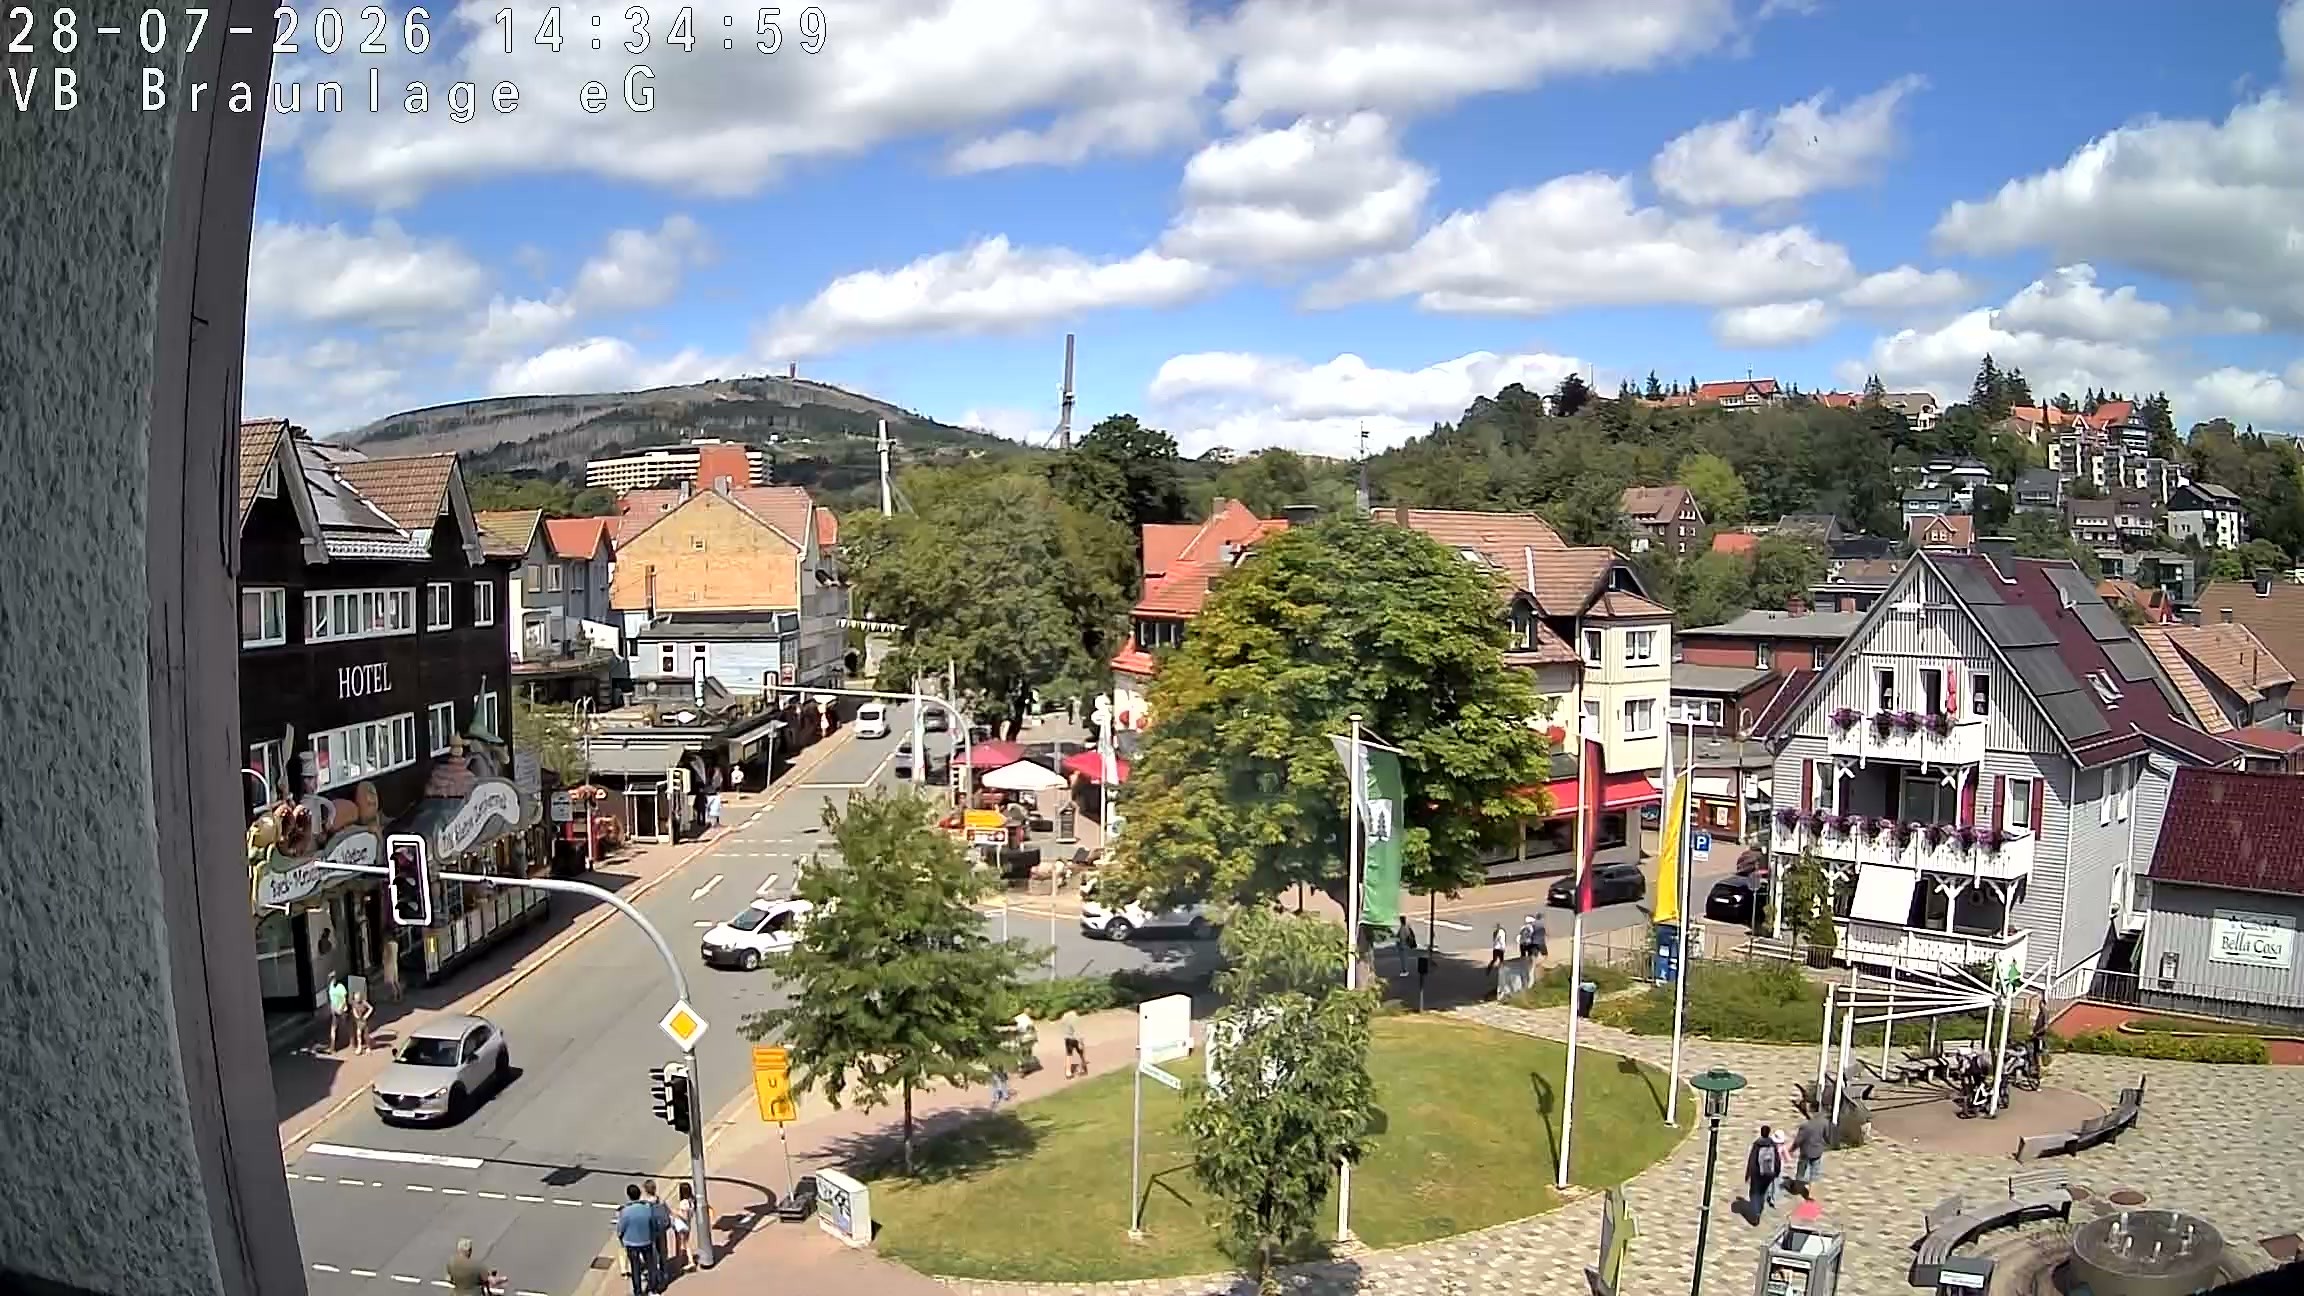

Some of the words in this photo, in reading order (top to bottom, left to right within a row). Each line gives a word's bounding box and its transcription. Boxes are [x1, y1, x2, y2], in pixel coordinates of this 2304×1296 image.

[338, 662, 392, 699] HOTEL
[1696, 836, 1707, 850] P
[2221, 931, 2250, 952] Bella
[2253, 939, 2282, 955] Casa
